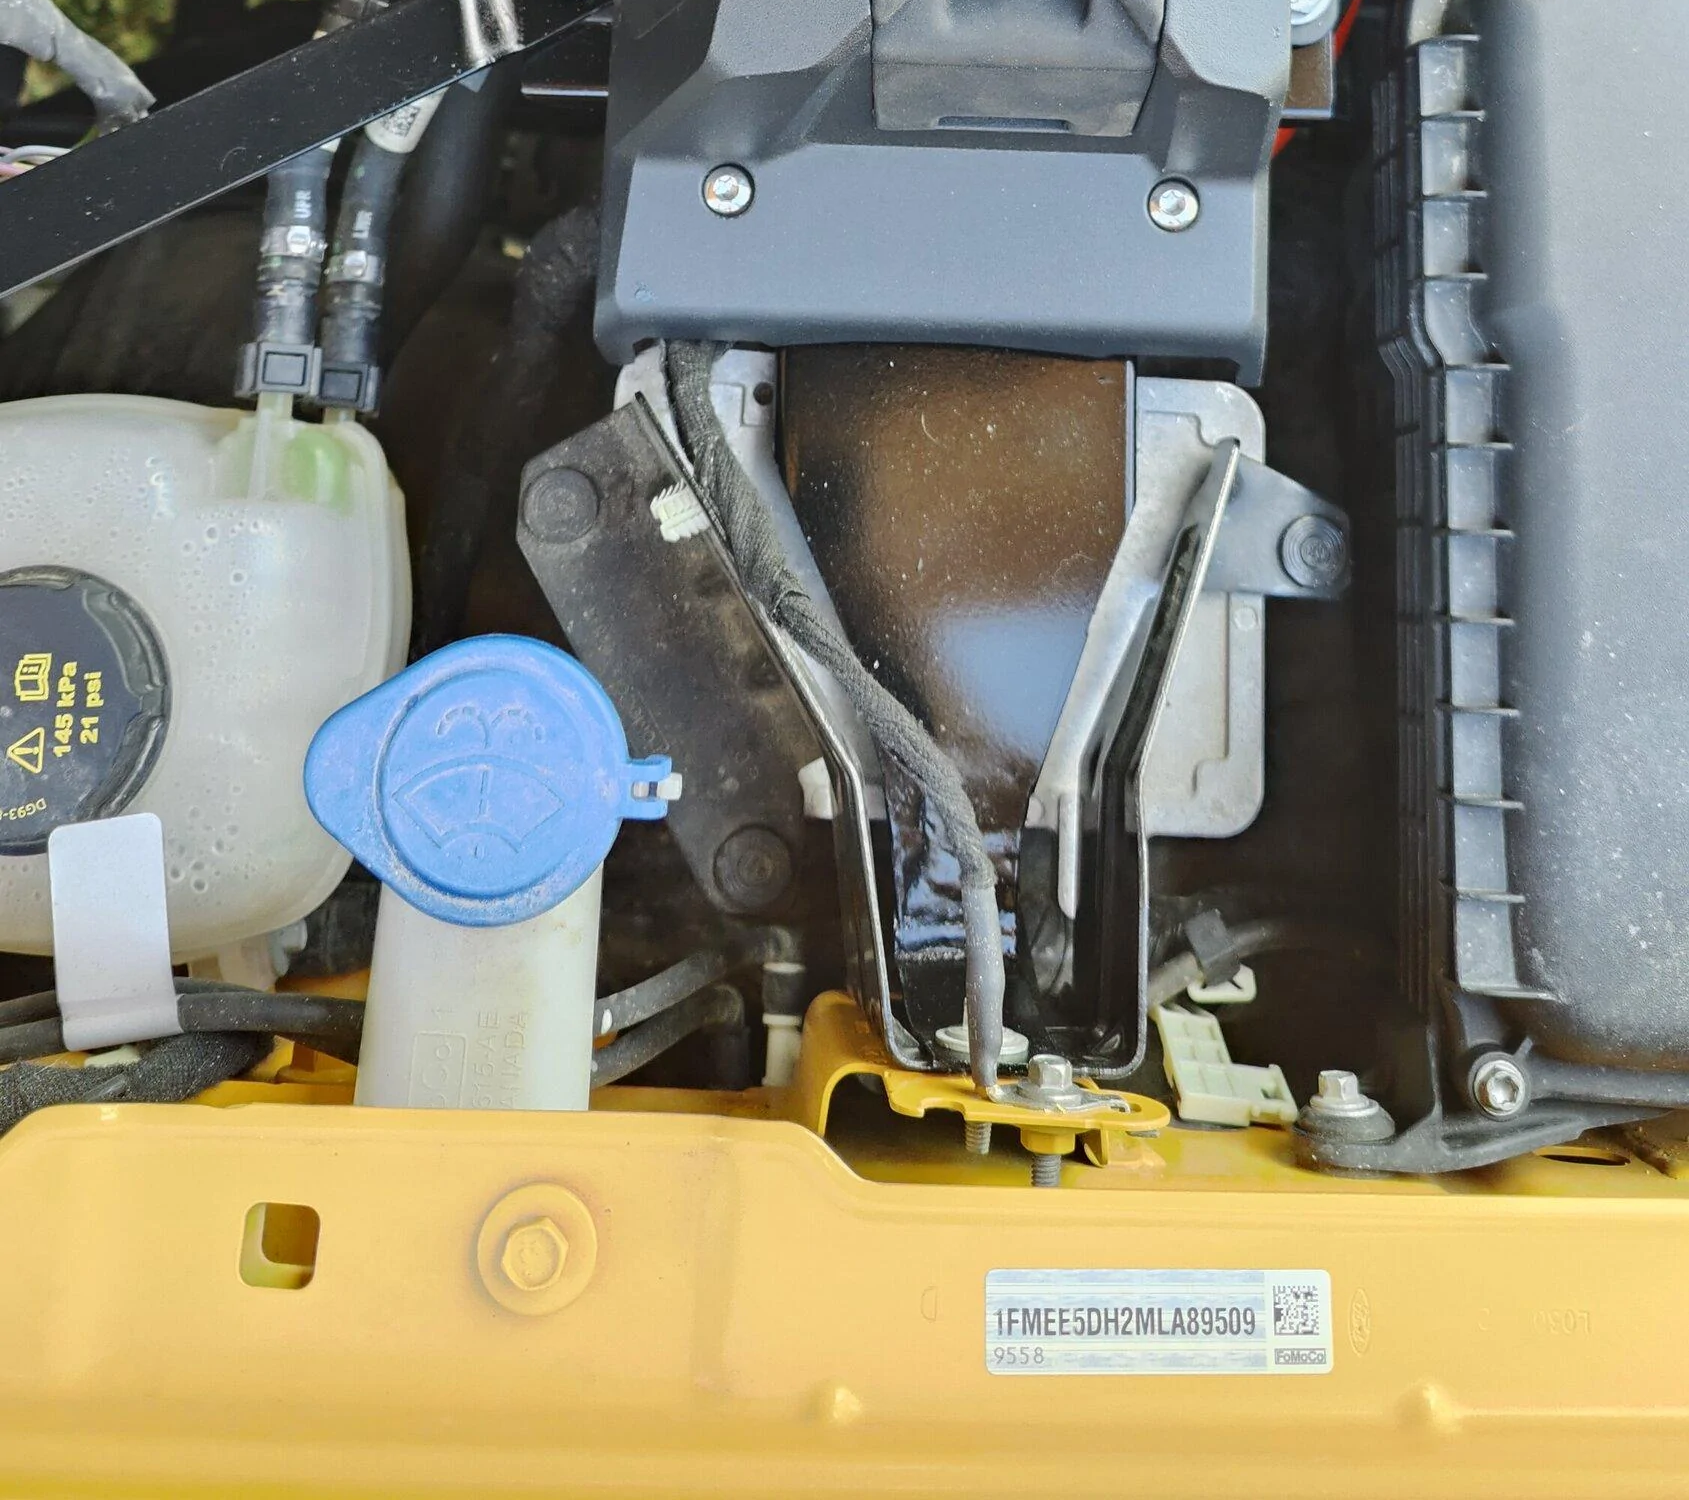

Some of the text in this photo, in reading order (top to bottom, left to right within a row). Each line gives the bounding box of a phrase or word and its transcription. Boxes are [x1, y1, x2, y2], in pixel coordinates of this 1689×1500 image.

[53, 661, 78, 758] 145 kPa
[80, 671, 104, 745] 21 psi
[994, 1306, 1256, 1336] 1FMEE5DH2MLA89509
[994, 1346, 1045, 1365] 9558
[1275, 1349, 1325, 1364] FoMoCo
